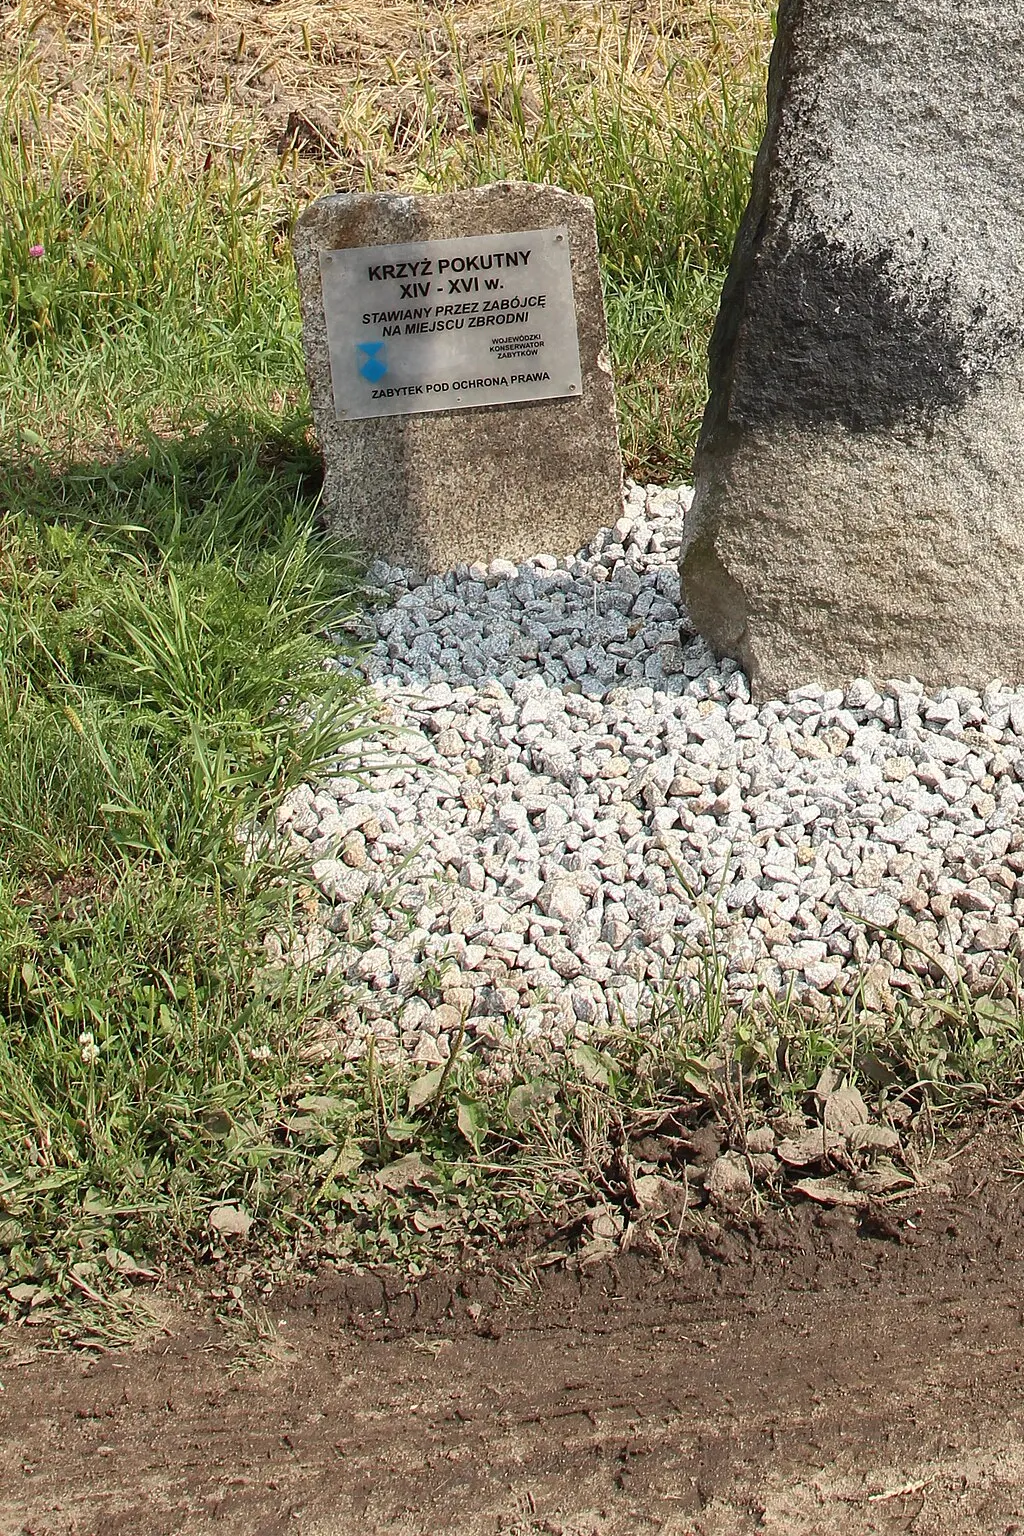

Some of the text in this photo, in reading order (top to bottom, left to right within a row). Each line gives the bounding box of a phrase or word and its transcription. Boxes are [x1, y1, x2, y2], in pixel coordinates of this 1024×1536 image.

[368, 250, 532, 281] KRZYŻ POKUTNY
[400, 282, 431, 300] XIV
[448, 277, 479, 294] XVI
[484, 278, 504, 290] w.
[362, 295, 547, 324] STAWIANY PRZEZ ZABÓJCĘ
[382, 312, 529, 337] NA MIEJSCU ZBRODNI
[489, 341, 545, 352] KONSERWATOR
[491, 334, 541, 344] WOJEWÓDZKI
[497, 349, 539, 360] ZABYTKÓW
[372, 371, 550, 399] ZABYTEK POD OCHRONĄ PRAWA
